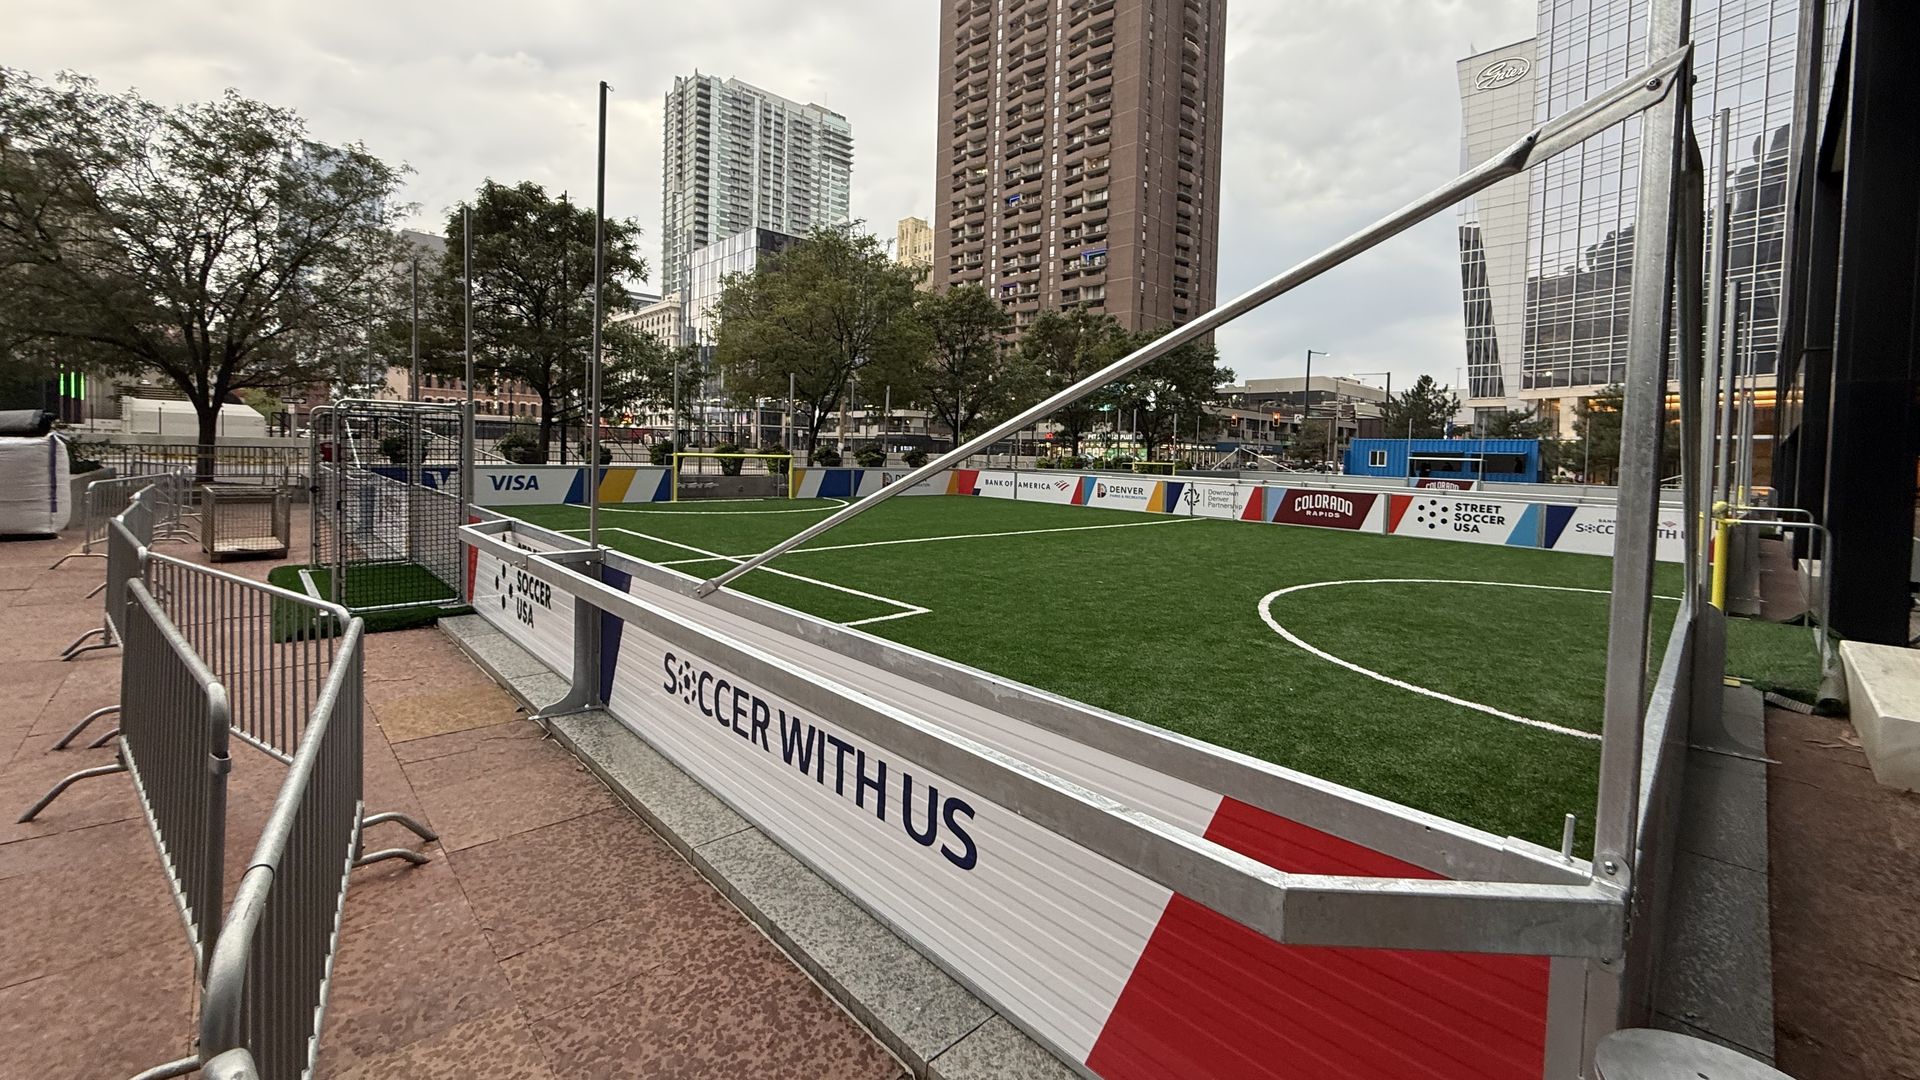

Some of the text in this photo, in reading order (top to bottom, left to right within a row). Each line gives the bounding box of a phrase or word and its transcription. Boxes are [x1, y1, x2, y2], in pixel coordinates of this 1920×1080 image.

[487, 475, 539, 490] VISA
[985, 479, 1004, 487] BANK
[1018, 482, 1051, 490] AMERICA
[1109, 485, 1144, 495] DENVER
[1207, 488, 1239, 497] Downtown
[1207, 501, 1243, 510] Partnership
[1294, 493, 1353, 517] COLORADO
[1454, 502, 1502, 515] STREET
[1305, 510, 1340, 519] RAPIDS
[1454, 512, 1506, 526] SOCCER
[1453, 522, 1481, 534] USA
[1575, 523, 1615, 535] SOCC
[516, 570, 552, 610] SOCCER
[516, 597, 534, 629] USA
[663, 652, 978, 871] SOCCER WITH US
